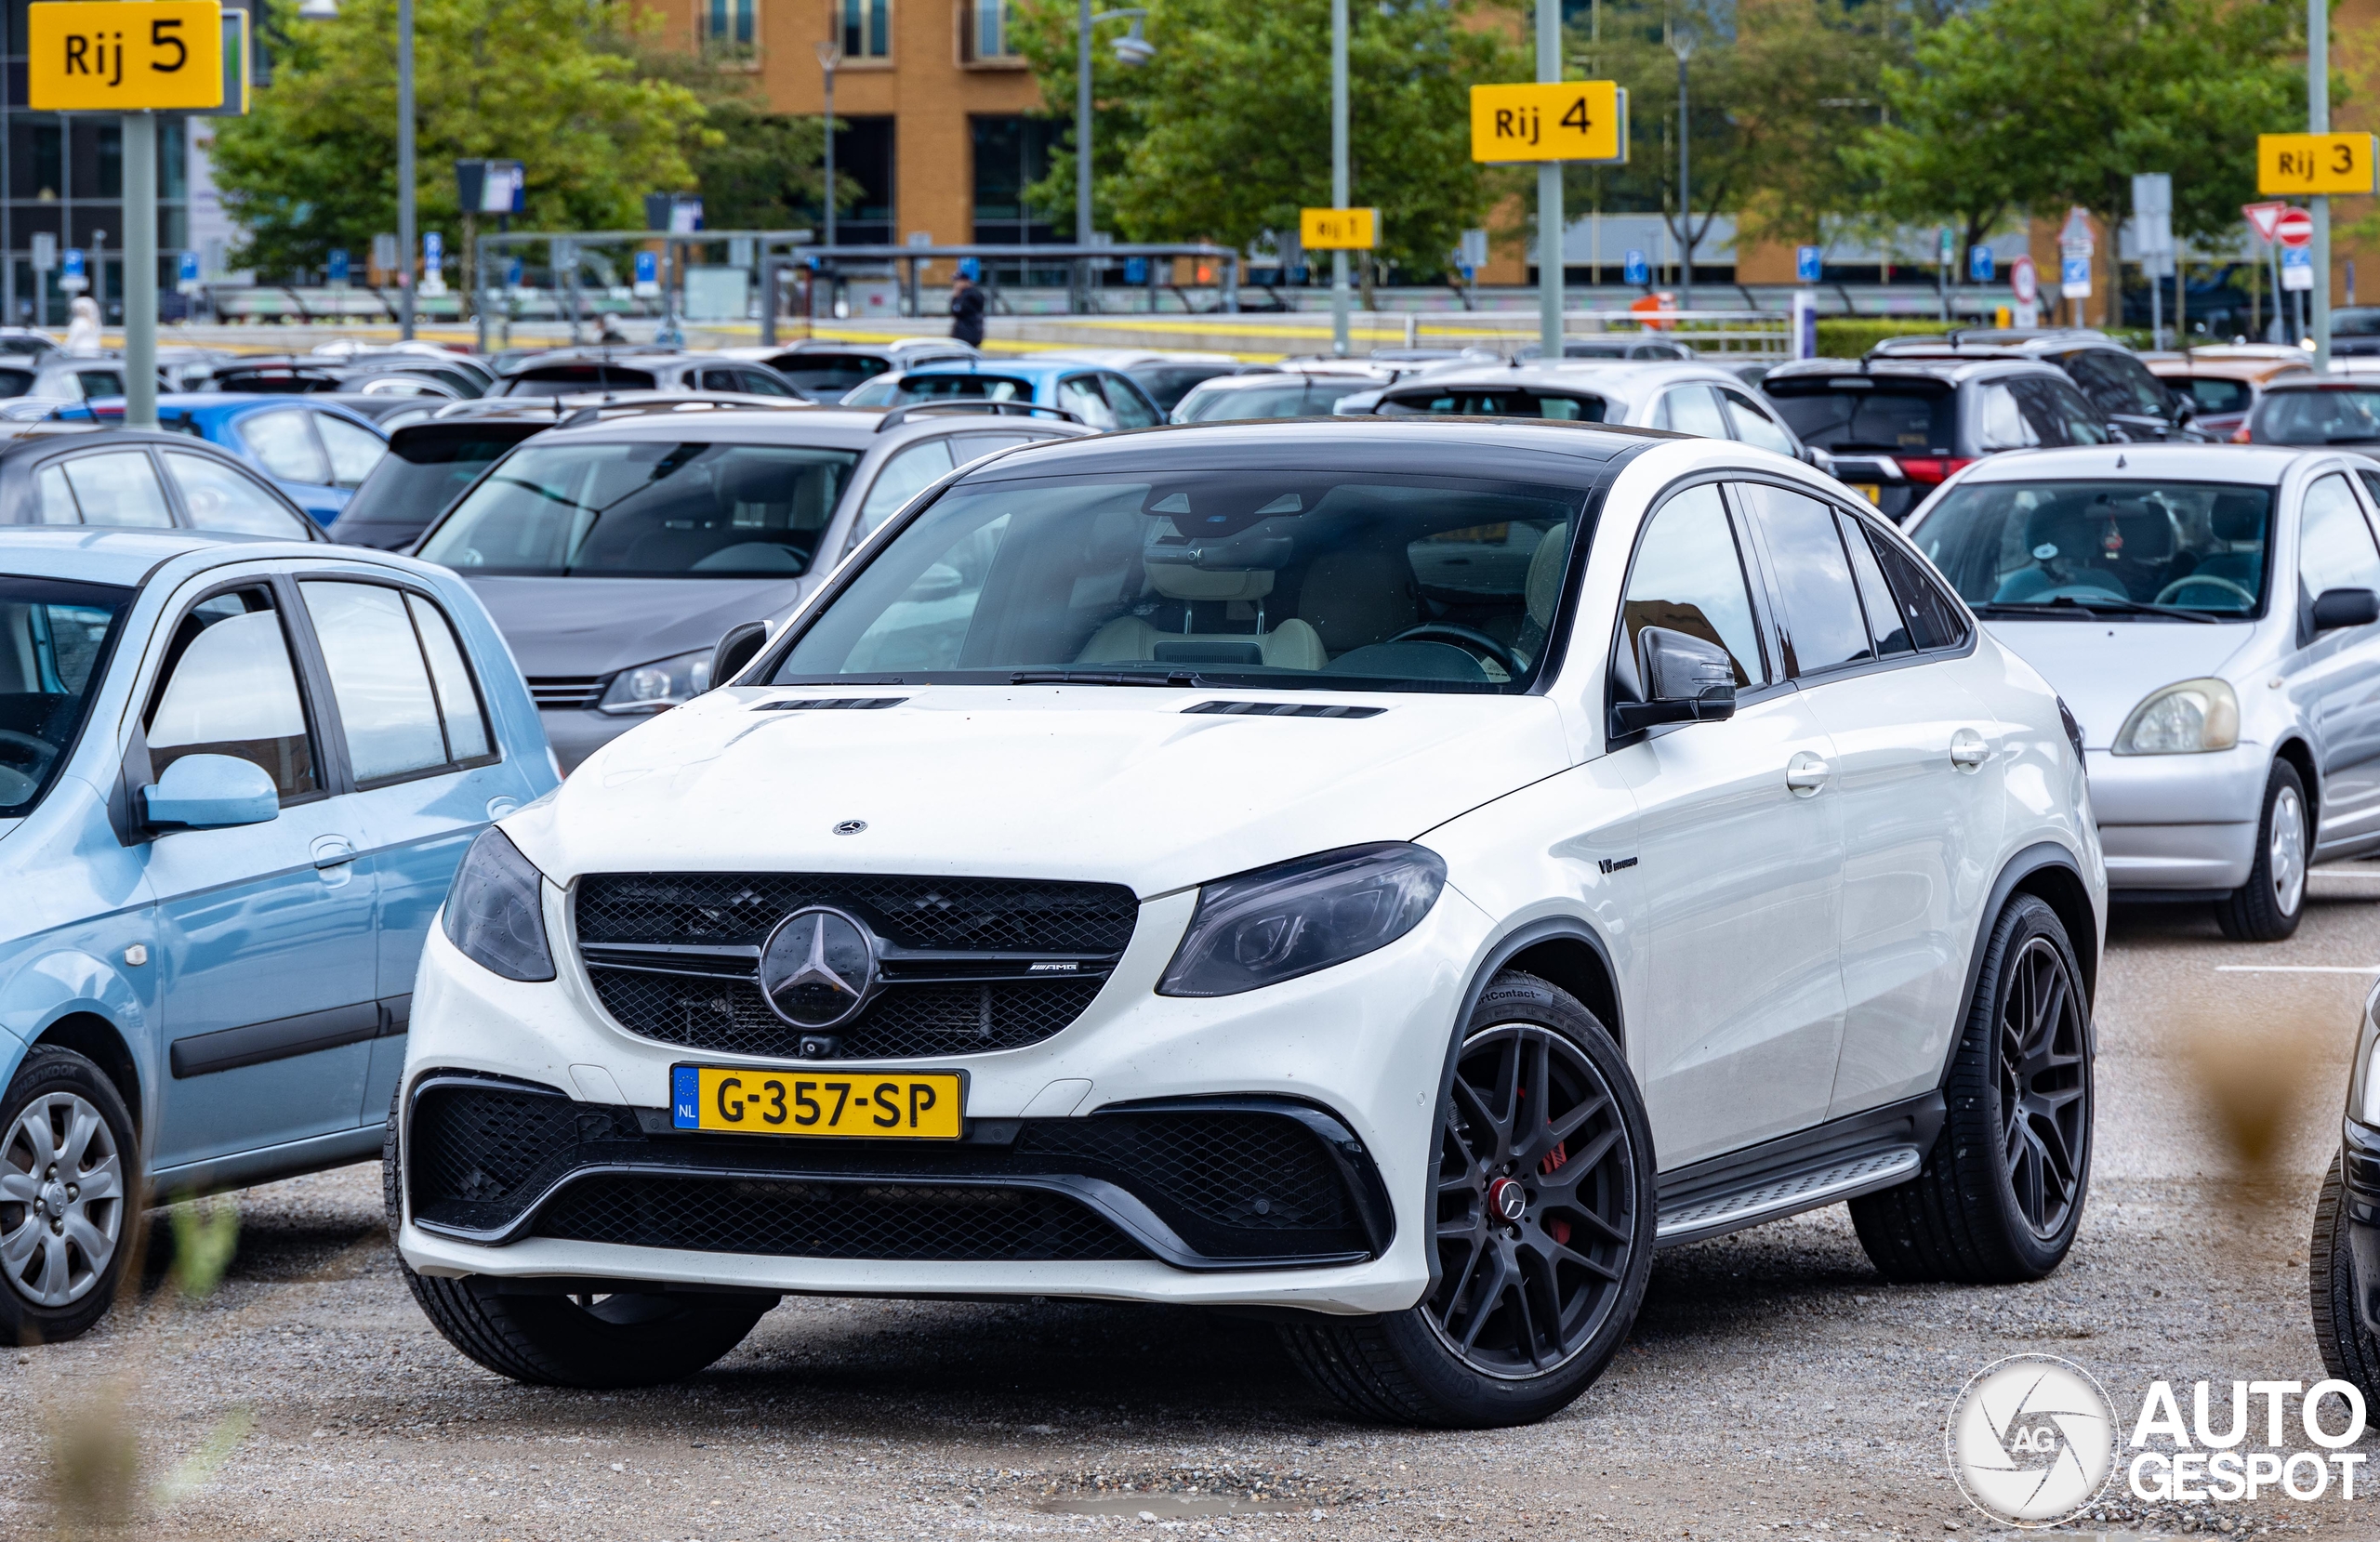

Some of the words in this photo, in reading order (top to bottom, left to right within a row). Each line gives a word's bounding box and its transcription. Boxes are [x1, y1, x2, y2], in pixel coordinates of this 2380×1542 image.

[65, 31, 123, 87] Rij
[151, 19, 189, 72] 5
[1495, 106, 1540, 146] Rij
[1559, 96, 1593, 135] 4
[2279, 150, 2314, 183] Rij
[2331, 143, 2353, 176] 3
[1598, 858, 1613, 875] V8
[678, 1103, 696, 1119] NL
[717, 1076, 937, 1128] G-357-SP
